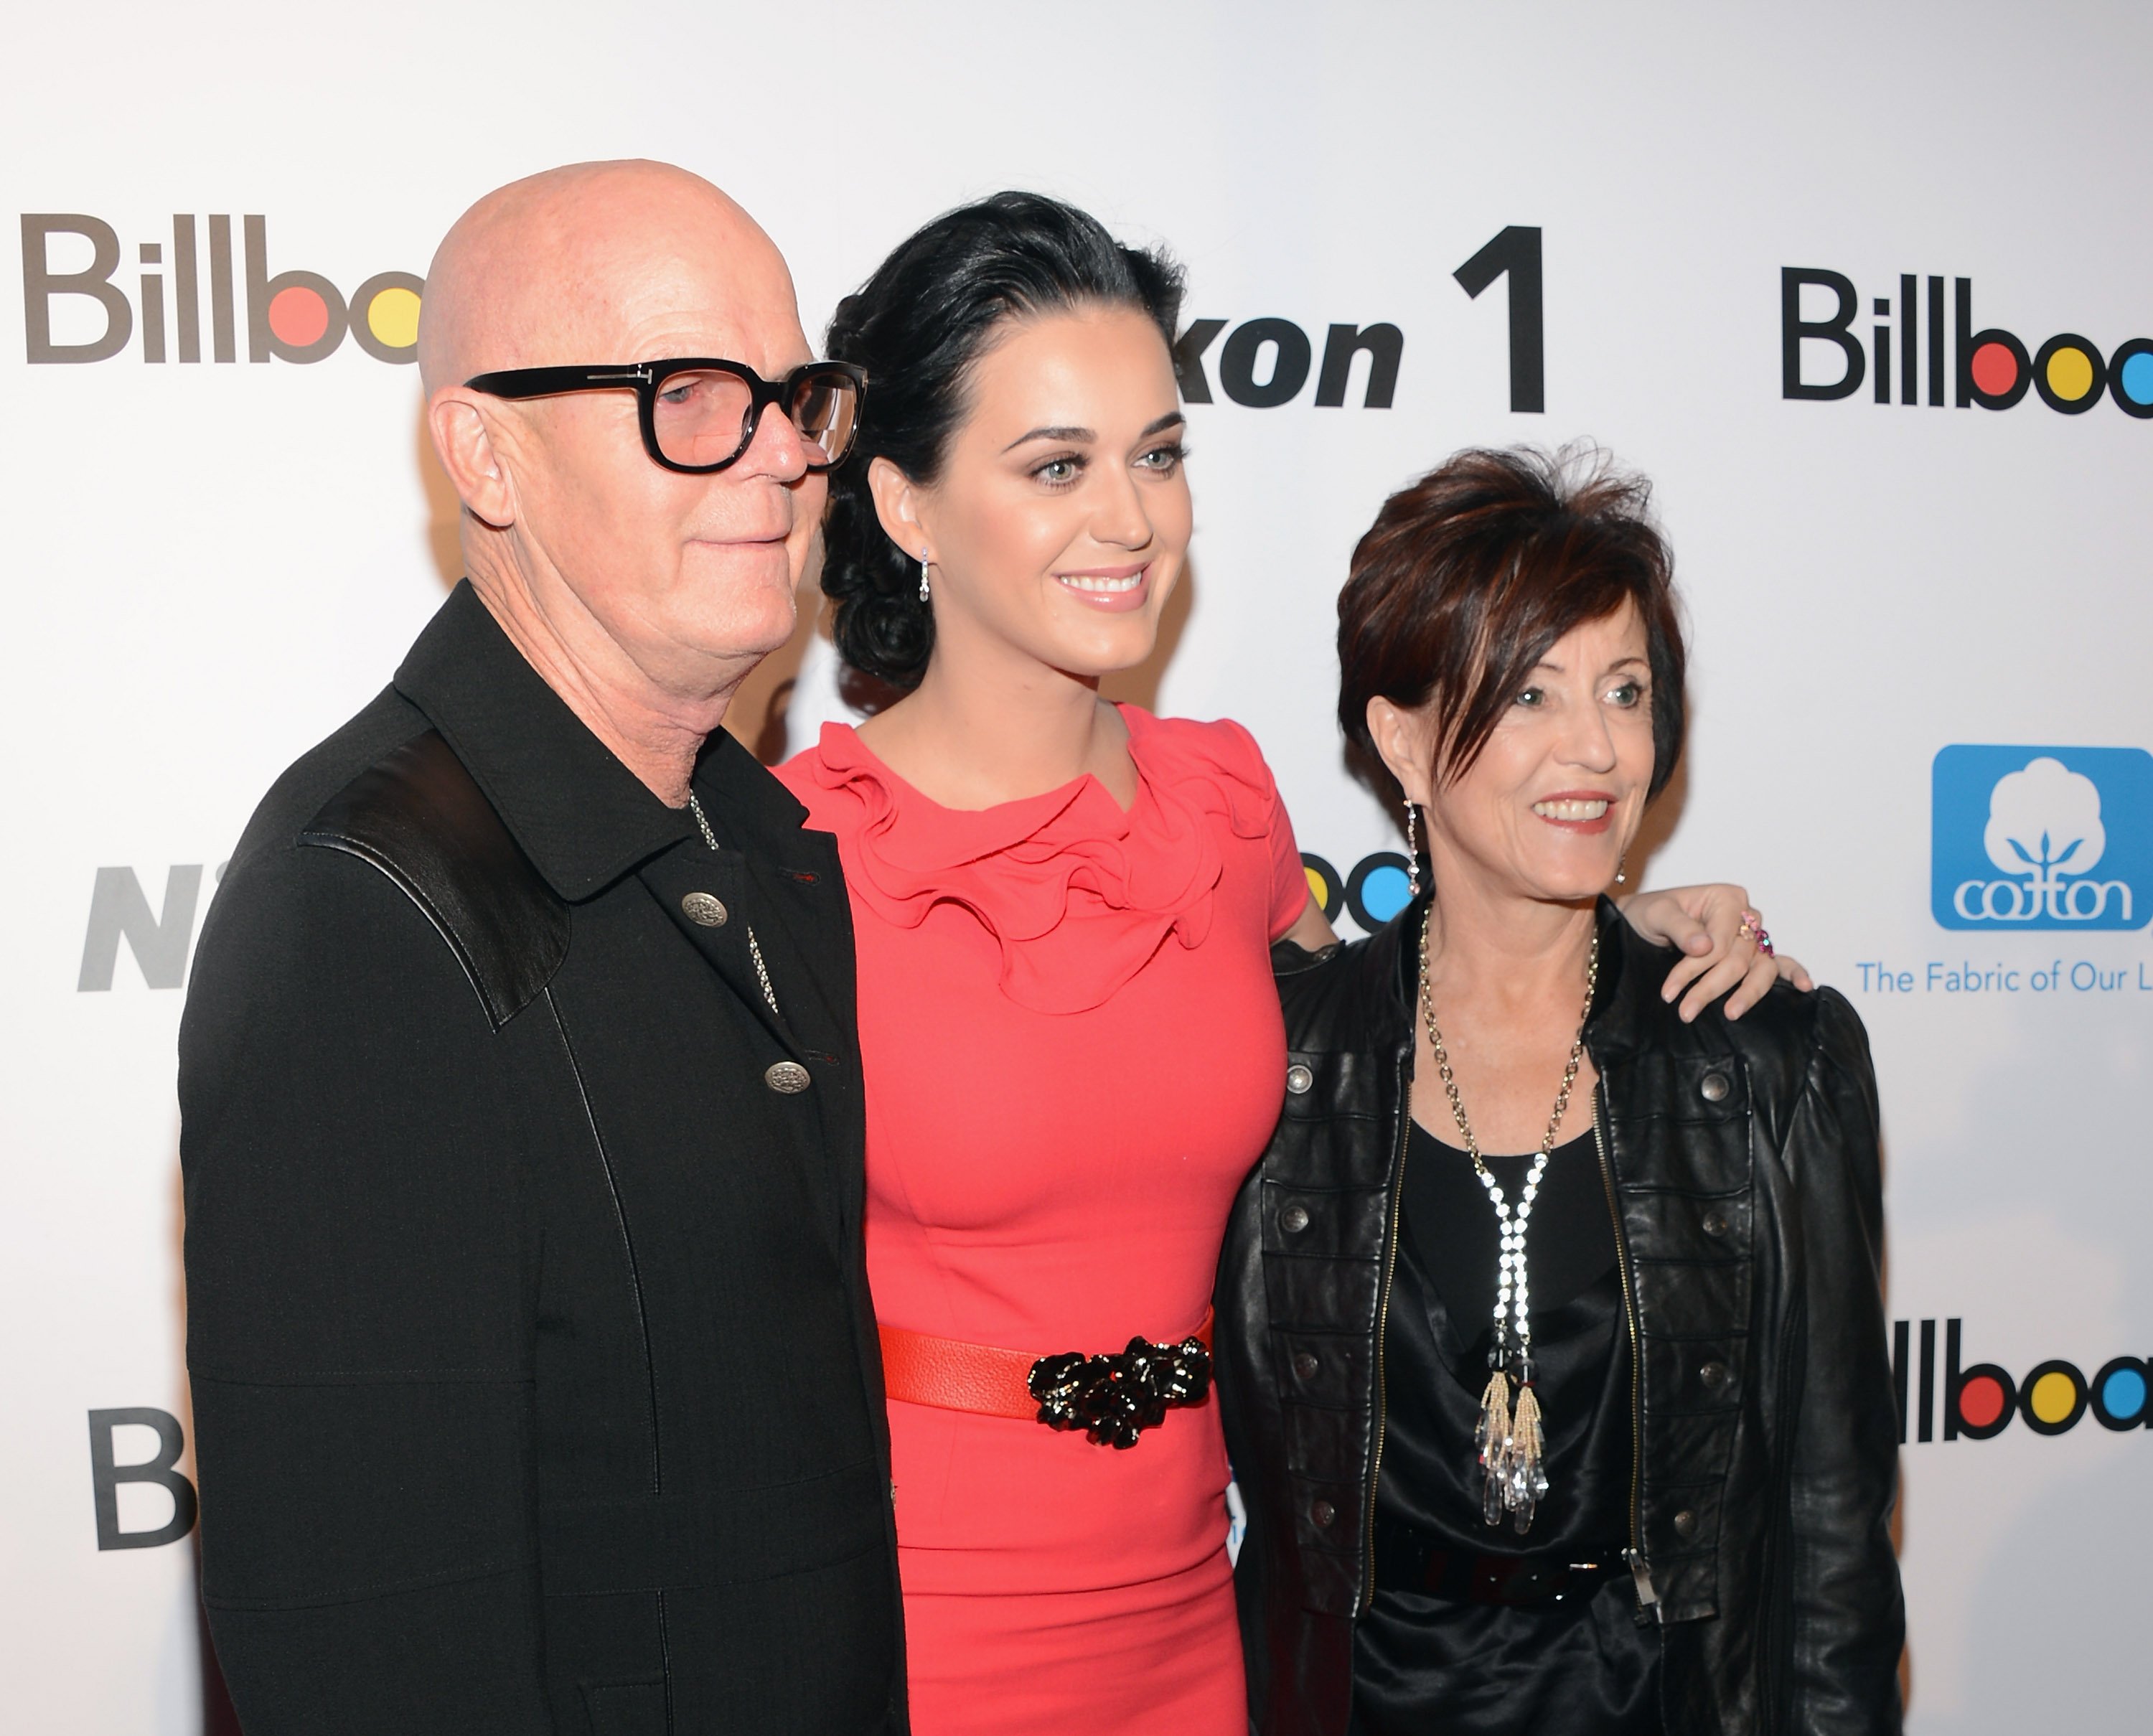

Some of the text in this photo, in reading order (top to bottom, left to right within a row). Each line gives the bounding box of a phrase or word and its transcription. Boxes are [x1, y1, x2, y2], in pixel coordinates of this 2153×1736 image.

[20, 213, 426, 365] Billbo
[1452, 225, 1545, 413] 1
[77, 860, 230, 992] N
[1953, 876, 2133, 921] cotton
[1856, 961, 1914, 992] The
[1927, 961, 2020, 992] Fabric
[2030, 960, 2061, 991] of
[2070, 962, 2127, 991] Our
[88, 1407, 198, 1551] B
